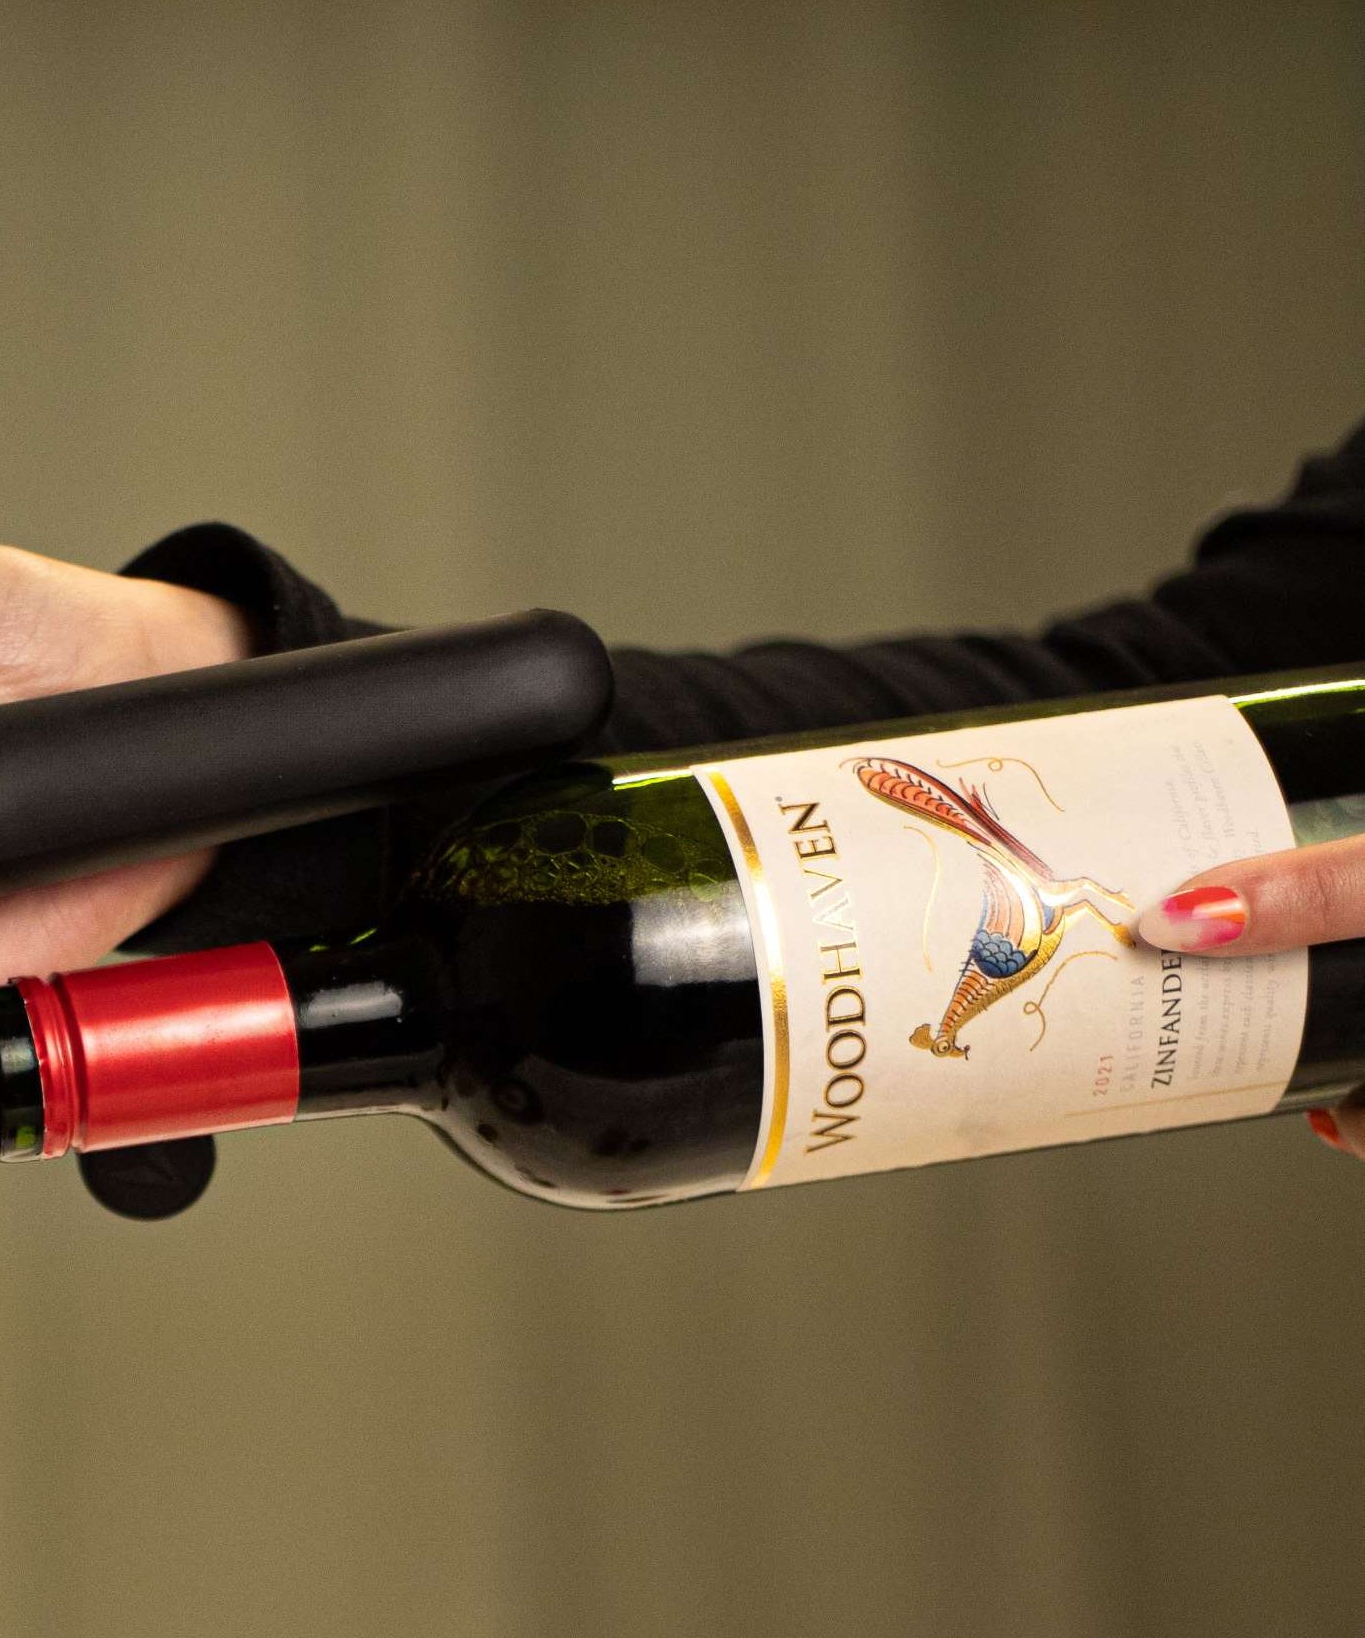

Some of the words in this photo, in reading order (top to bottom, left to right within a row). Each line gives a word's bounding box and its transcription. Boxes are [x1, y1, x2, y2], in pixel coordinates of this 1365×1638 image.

[779, 801, 869, 1154] WOODHAVEN
[1120, 974, 1146, 1093] CALIFORNIA
[1093, 1055, 1114, 1097] 2021
